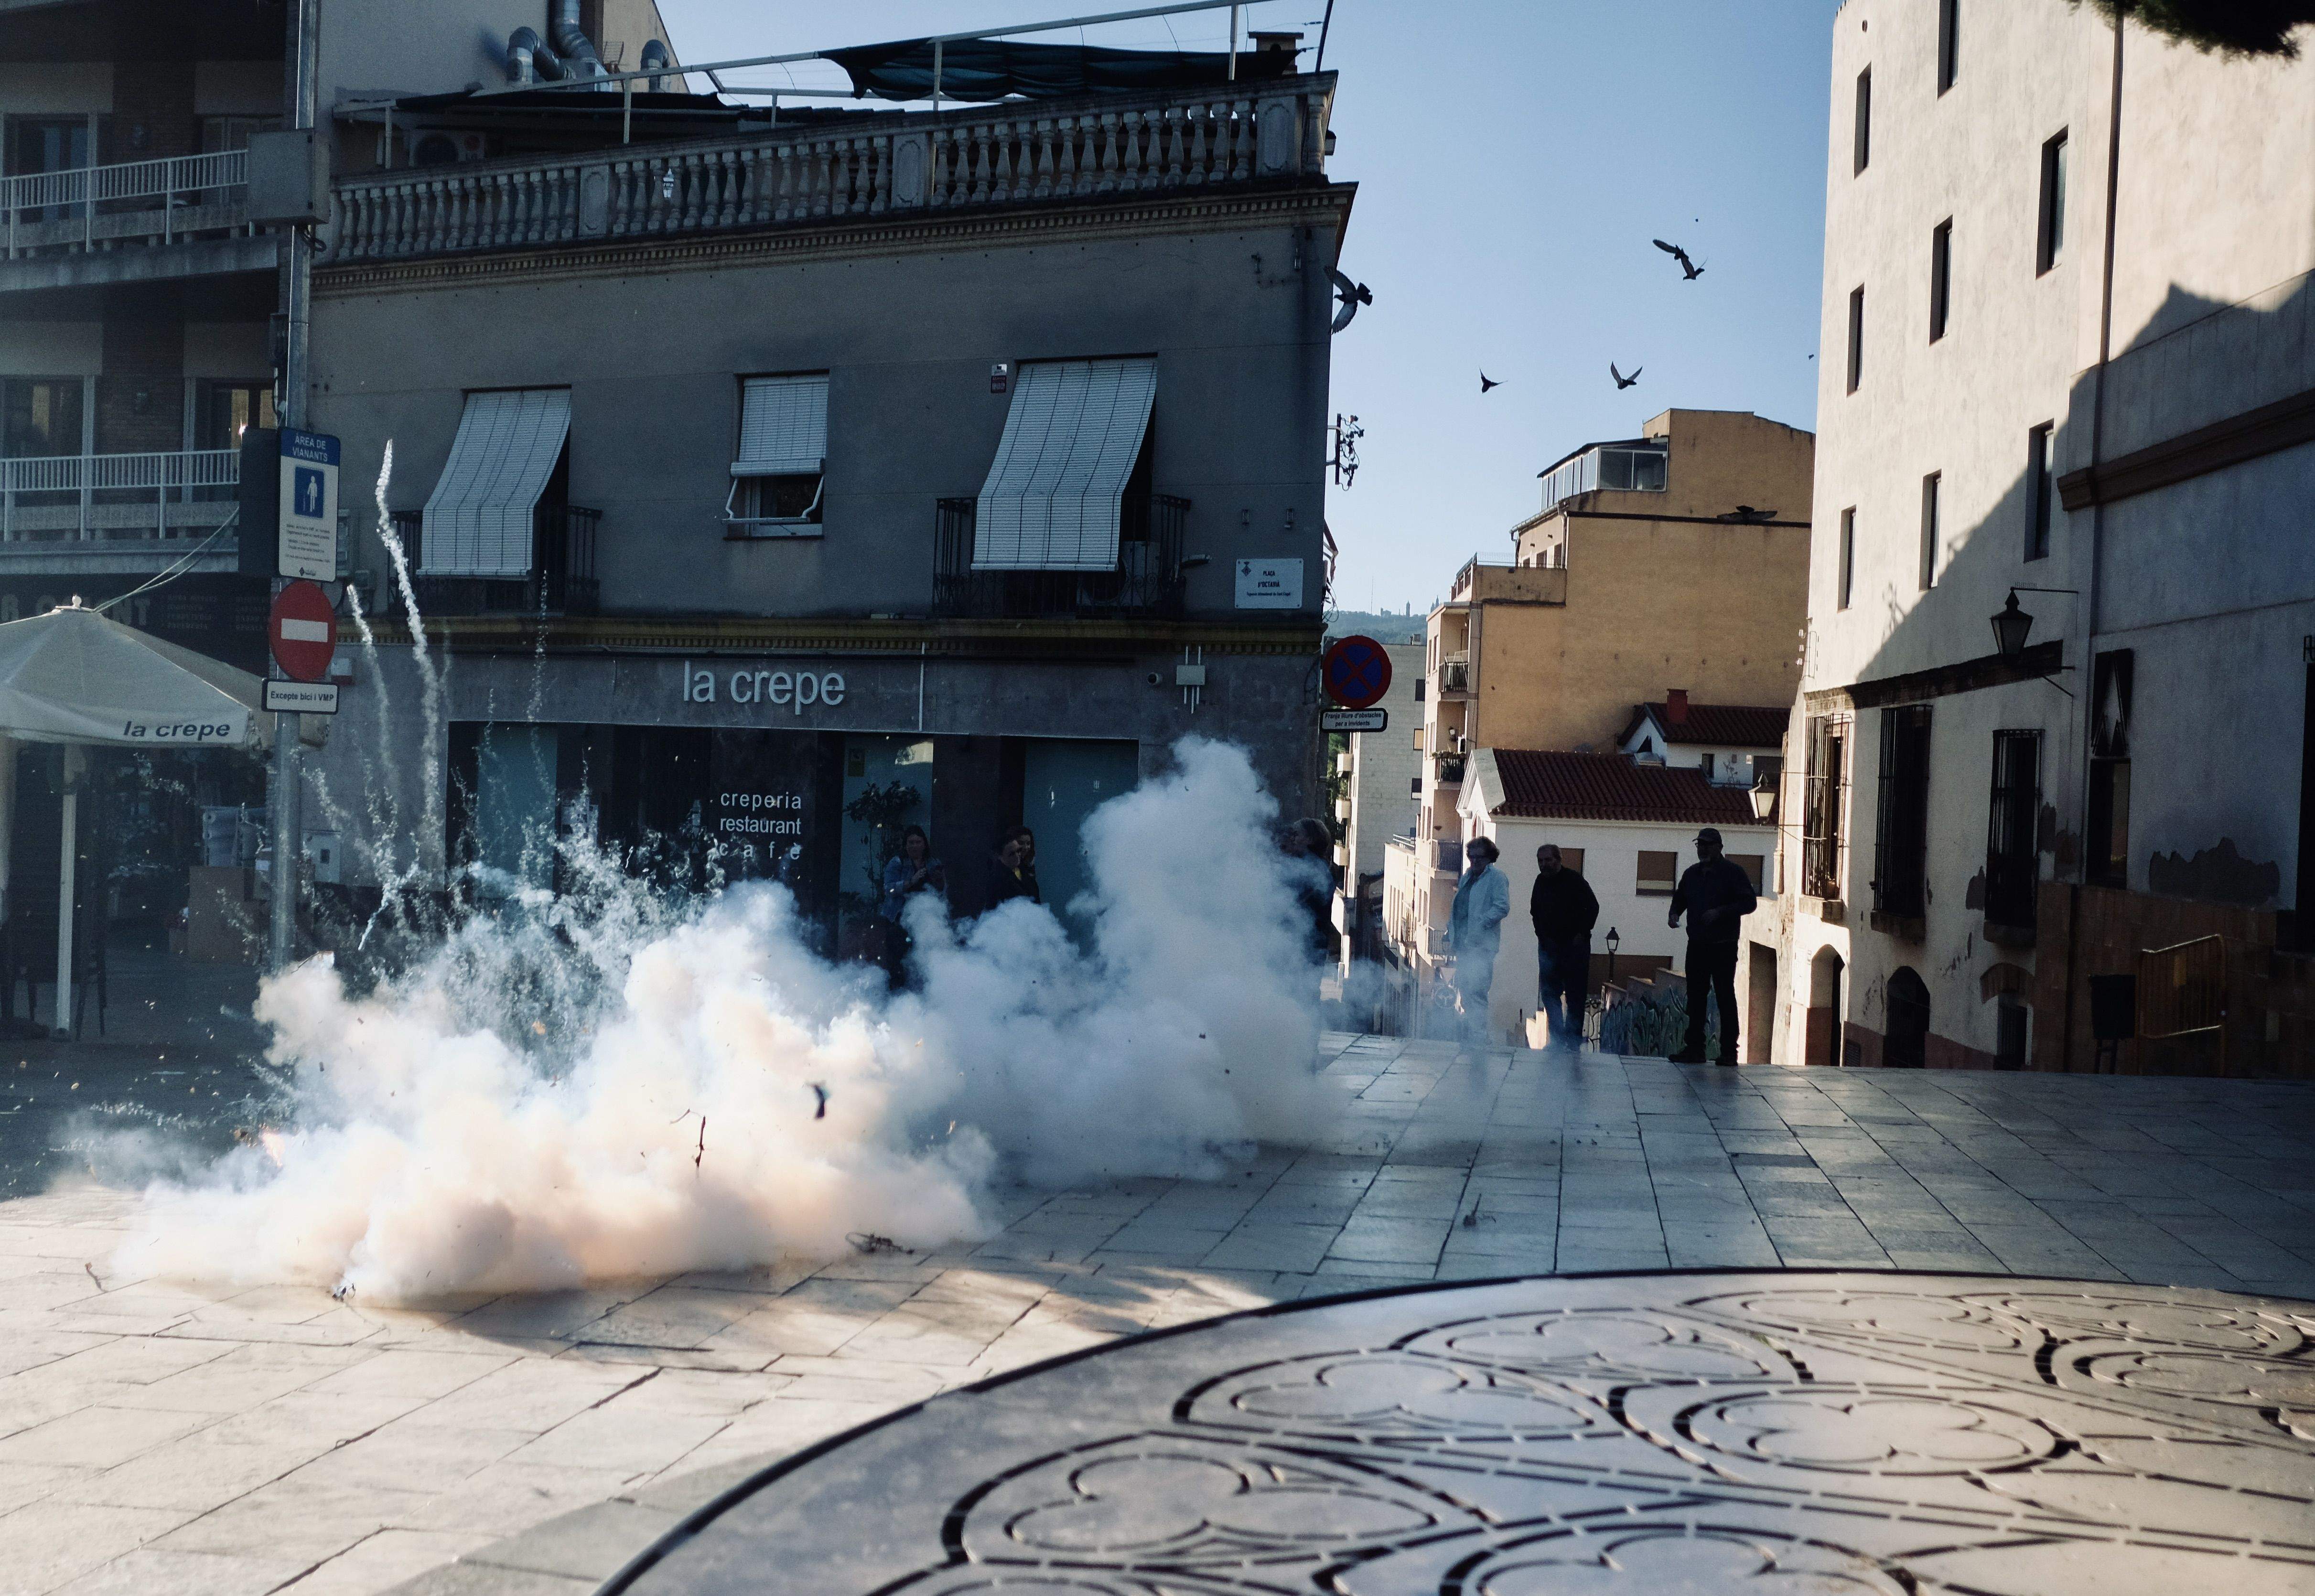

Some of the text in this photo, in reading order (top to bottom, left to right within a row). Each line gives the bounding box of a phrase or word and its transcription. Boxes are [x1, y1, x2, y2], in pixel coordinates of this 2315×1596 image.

[292, 447, 328, 462] VIANANTS
[316, 439, 326, 450] DE
[270, 691, 299, 701] Excepte
[300, 693, 312, 701] bici
[318, 694, 334, 702] VMP
[683, 660, 846, 716] la crepe
[123, 720, 230, 741] la crepe
[720, 792, 801, 812] creperia
[720, 815, 801, 835] restaurant
